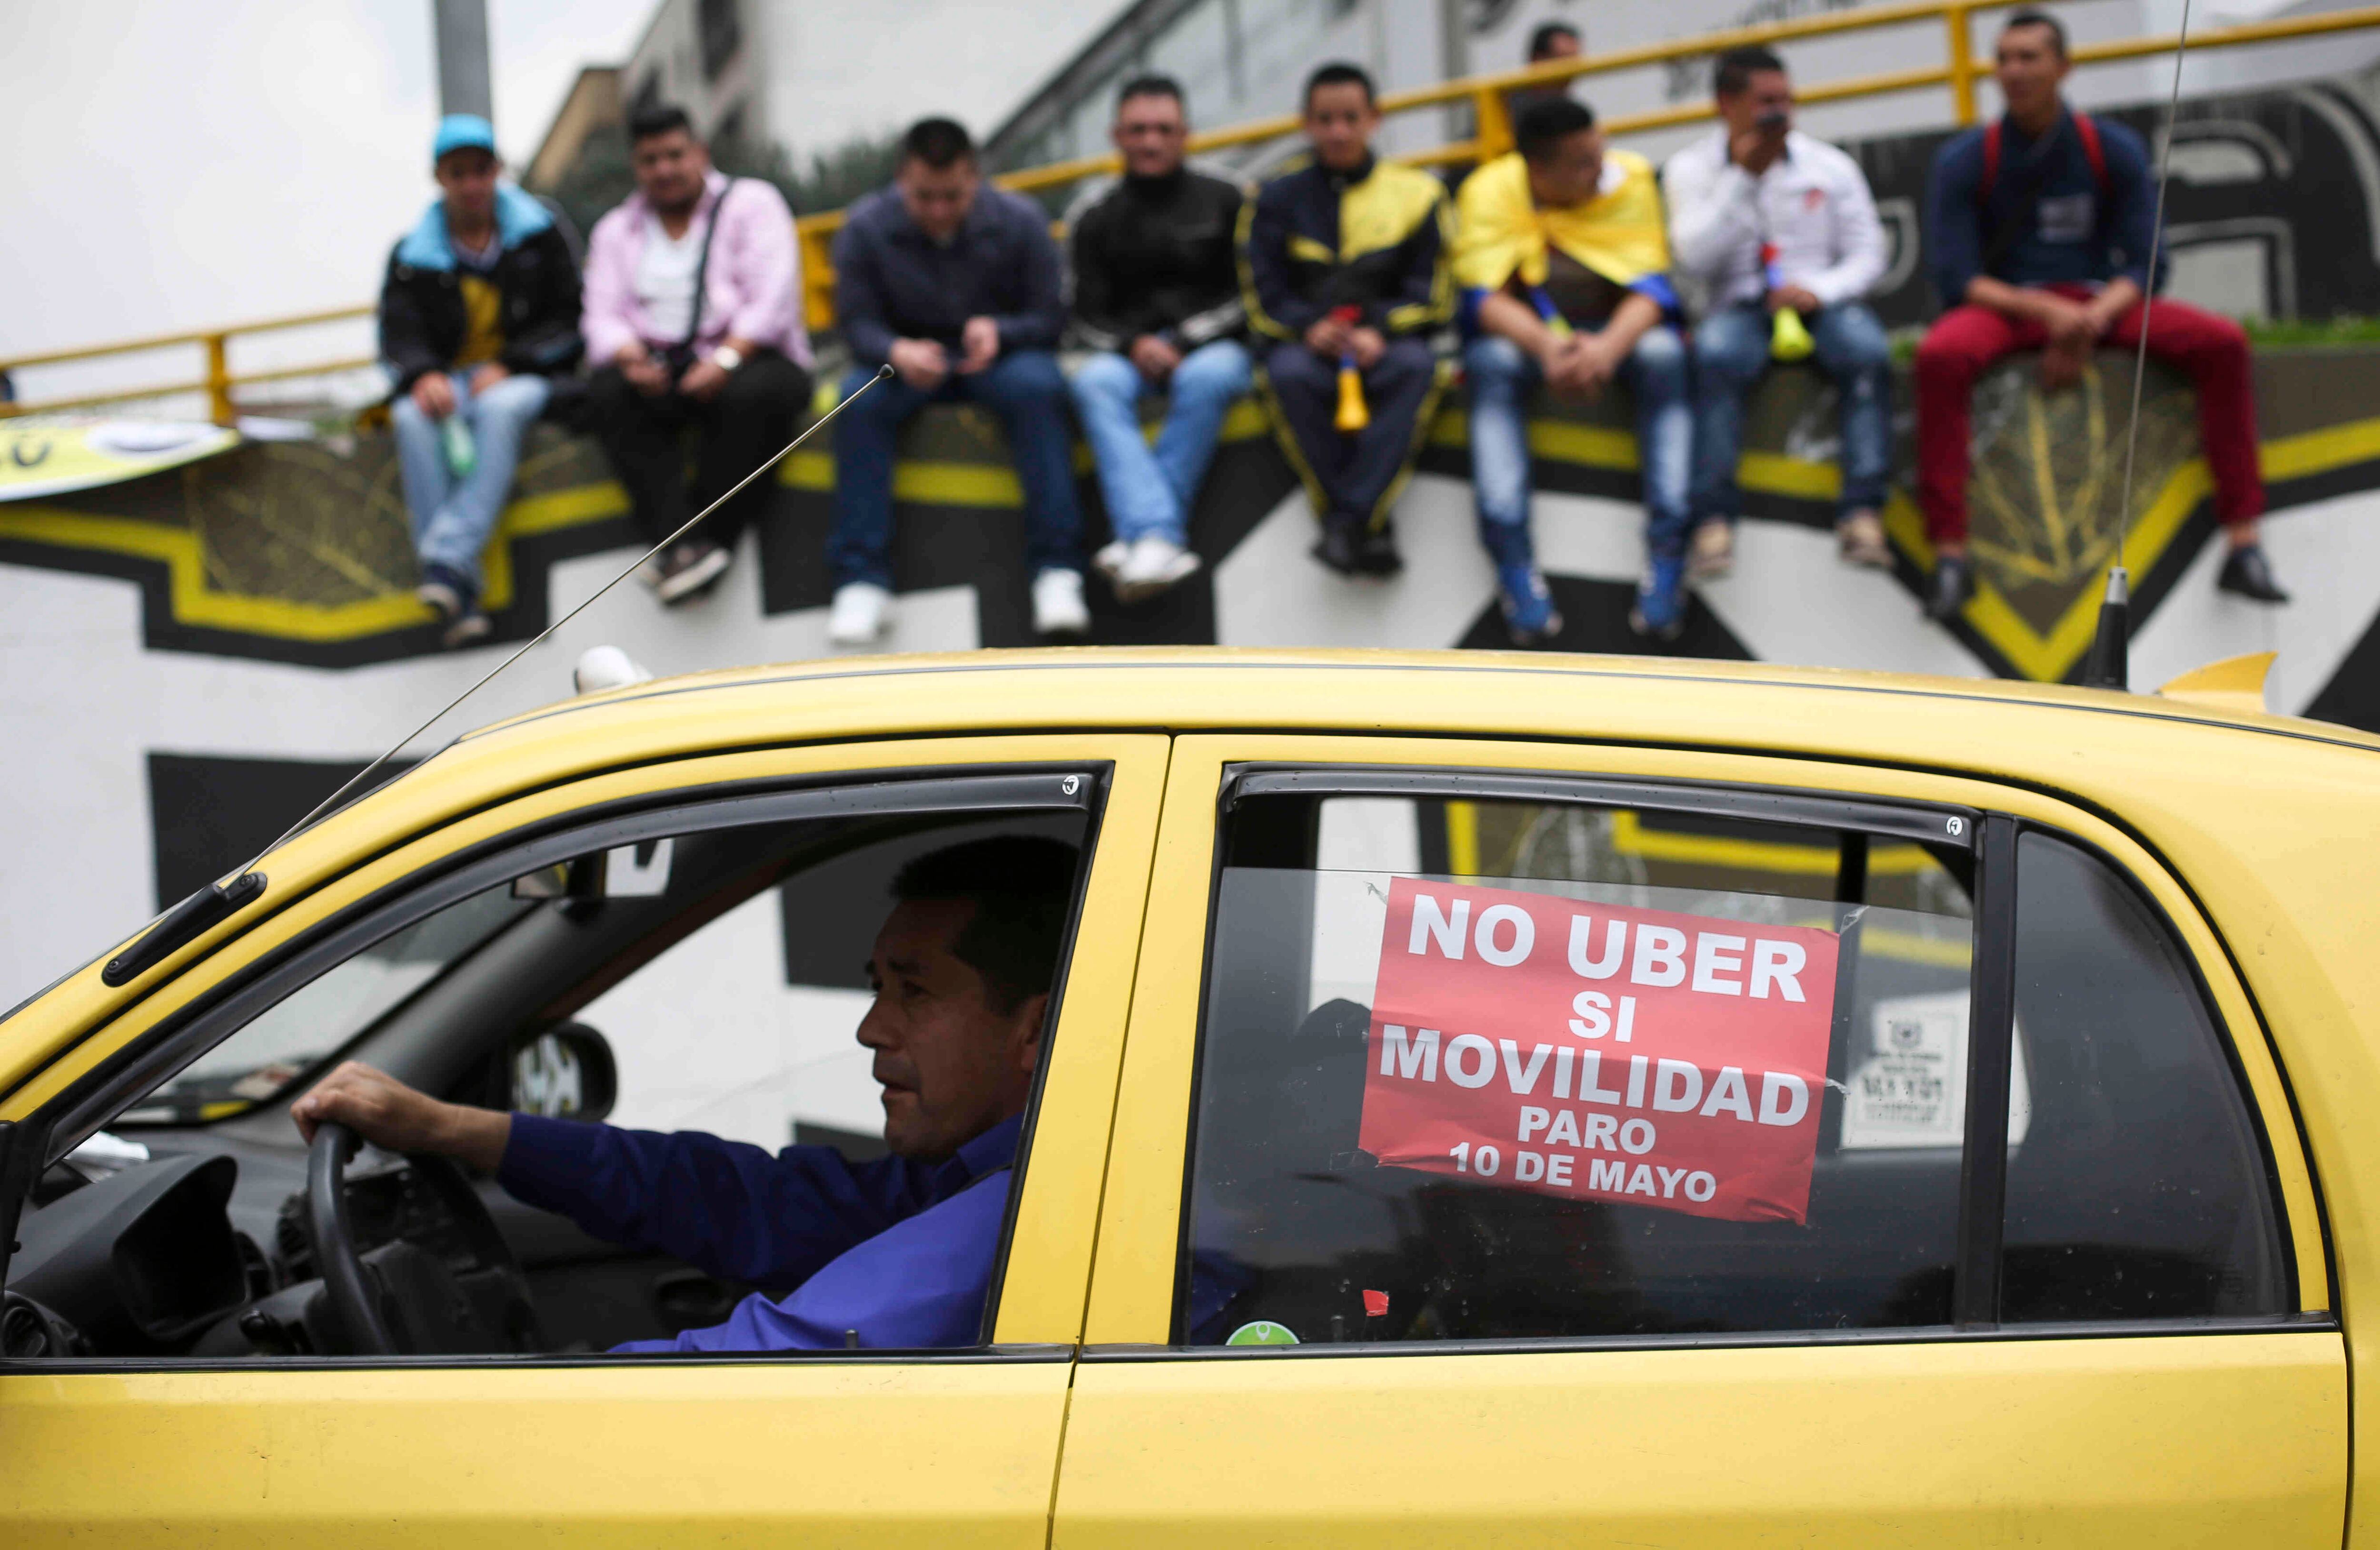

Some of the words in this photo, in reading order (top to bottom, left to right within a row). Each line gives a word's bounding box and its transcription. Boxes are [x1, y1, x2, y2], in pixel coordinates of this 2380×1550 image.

[1408, 894, 1536, 967] NO
[1567, 914, 1807, 1003] UBER
[1568, 991, 1636, 1043] SI
[1379, 1024, 1810, 1127] MOVILIDAD
[1517, 1105, 1656, 1155] PARO
[1449, 1142, 1500, 1176] 10
[1515, 1151, 1575, 1187] DE
[1588, 1158, 1716, 1203] MAYO
